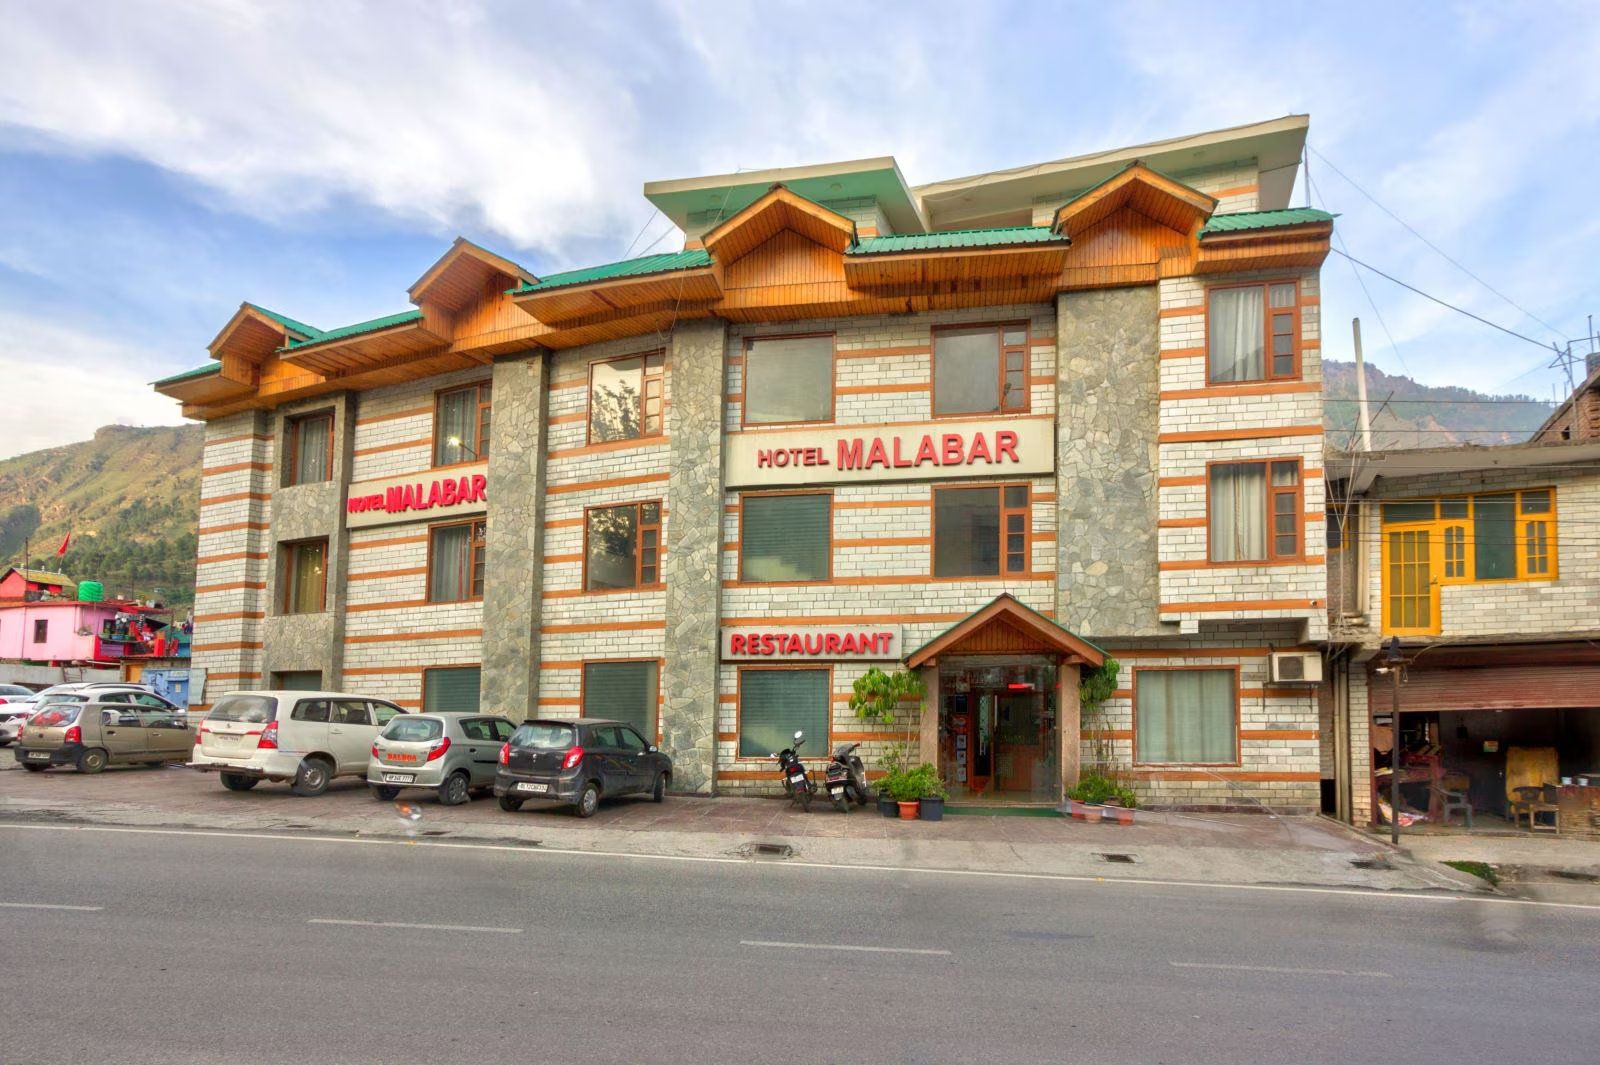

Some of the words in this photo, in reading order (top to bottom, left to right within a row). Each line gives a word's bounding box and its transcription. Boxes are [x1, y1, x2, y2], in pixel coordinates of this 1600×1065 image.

[757, 447, 829, 468] HOTEL
[837, 430, 1020, 471] MALABAR
[347, 494, 386, 513] HOTEL
[386, 474, 487, 513] MALABAR
[730, 632, 894, 655] RESTAURANT
